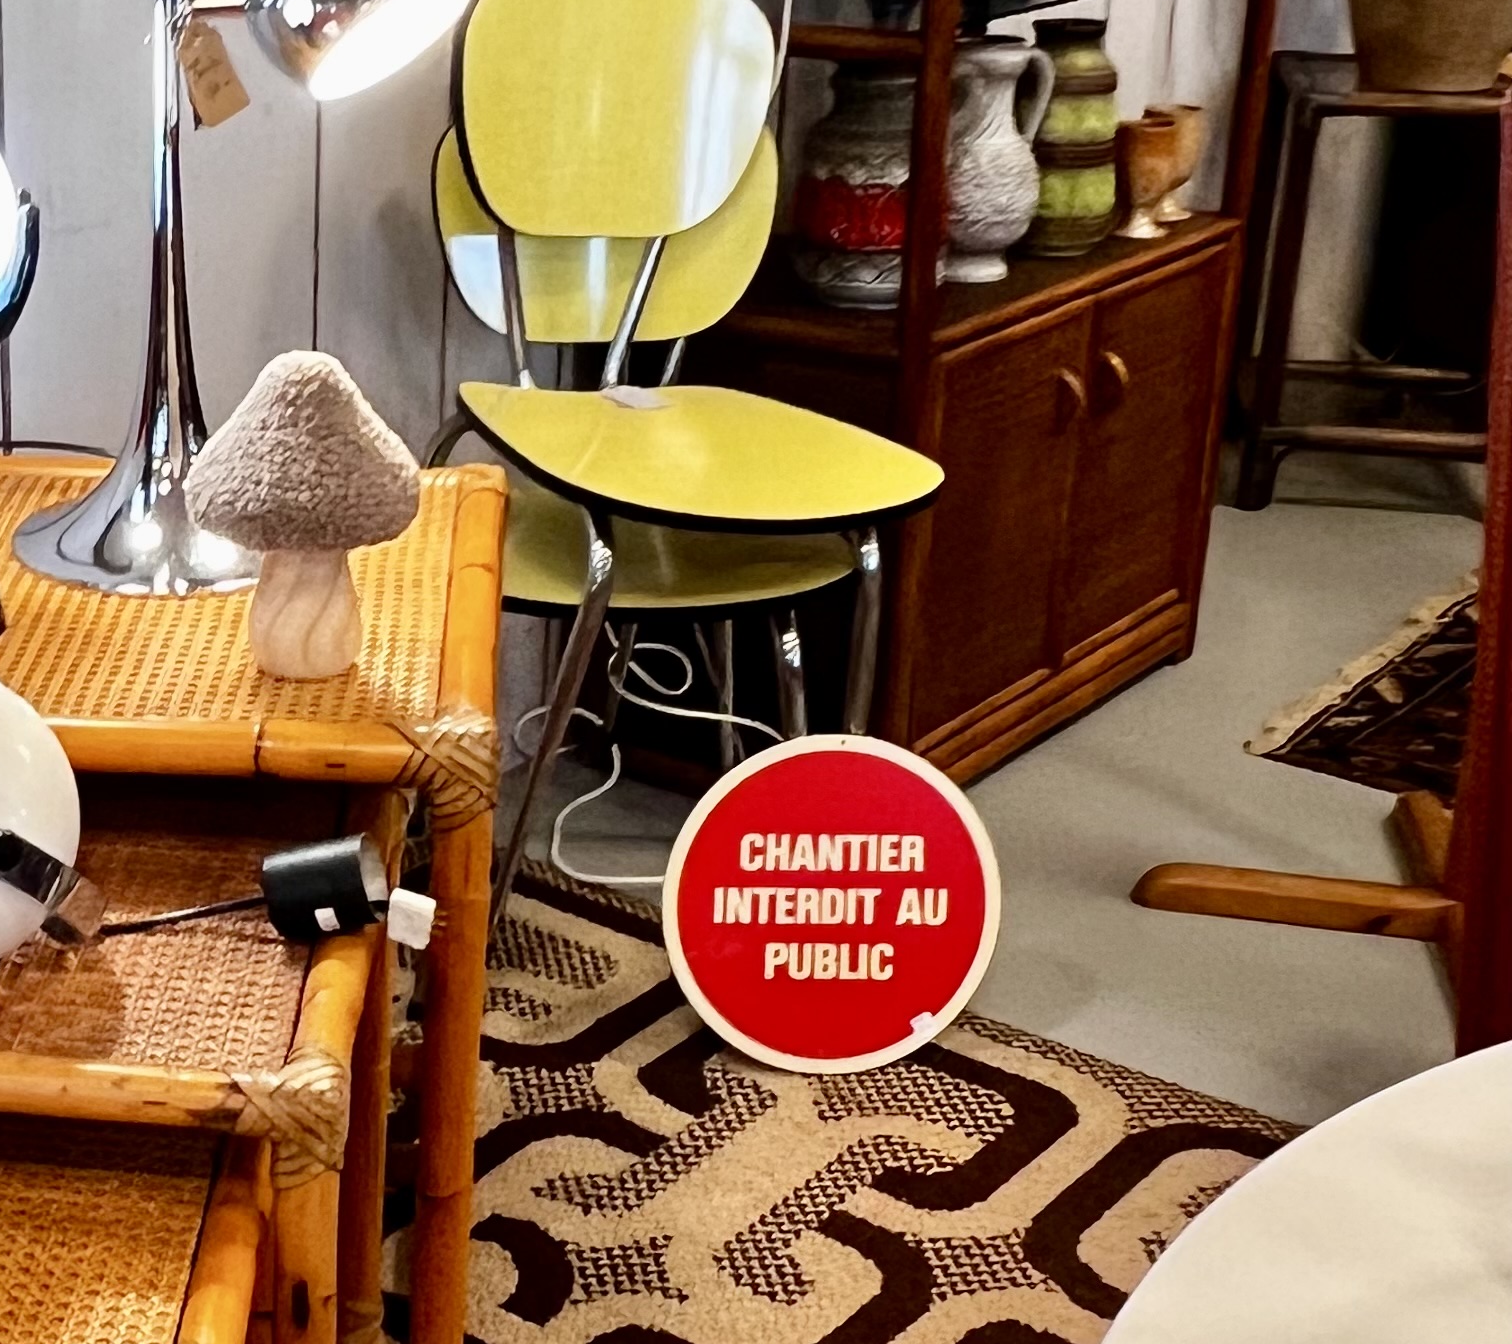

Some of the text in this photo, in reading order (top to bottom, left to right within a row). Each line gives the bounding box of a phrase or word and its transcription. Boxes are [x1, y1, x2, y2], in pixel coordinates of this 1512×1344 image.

[740, 833, 925, 873] CHANTIER
[713, 887, 949, 926] INTERDIT AU
[763, 942, 895, 981] PUBLIC
